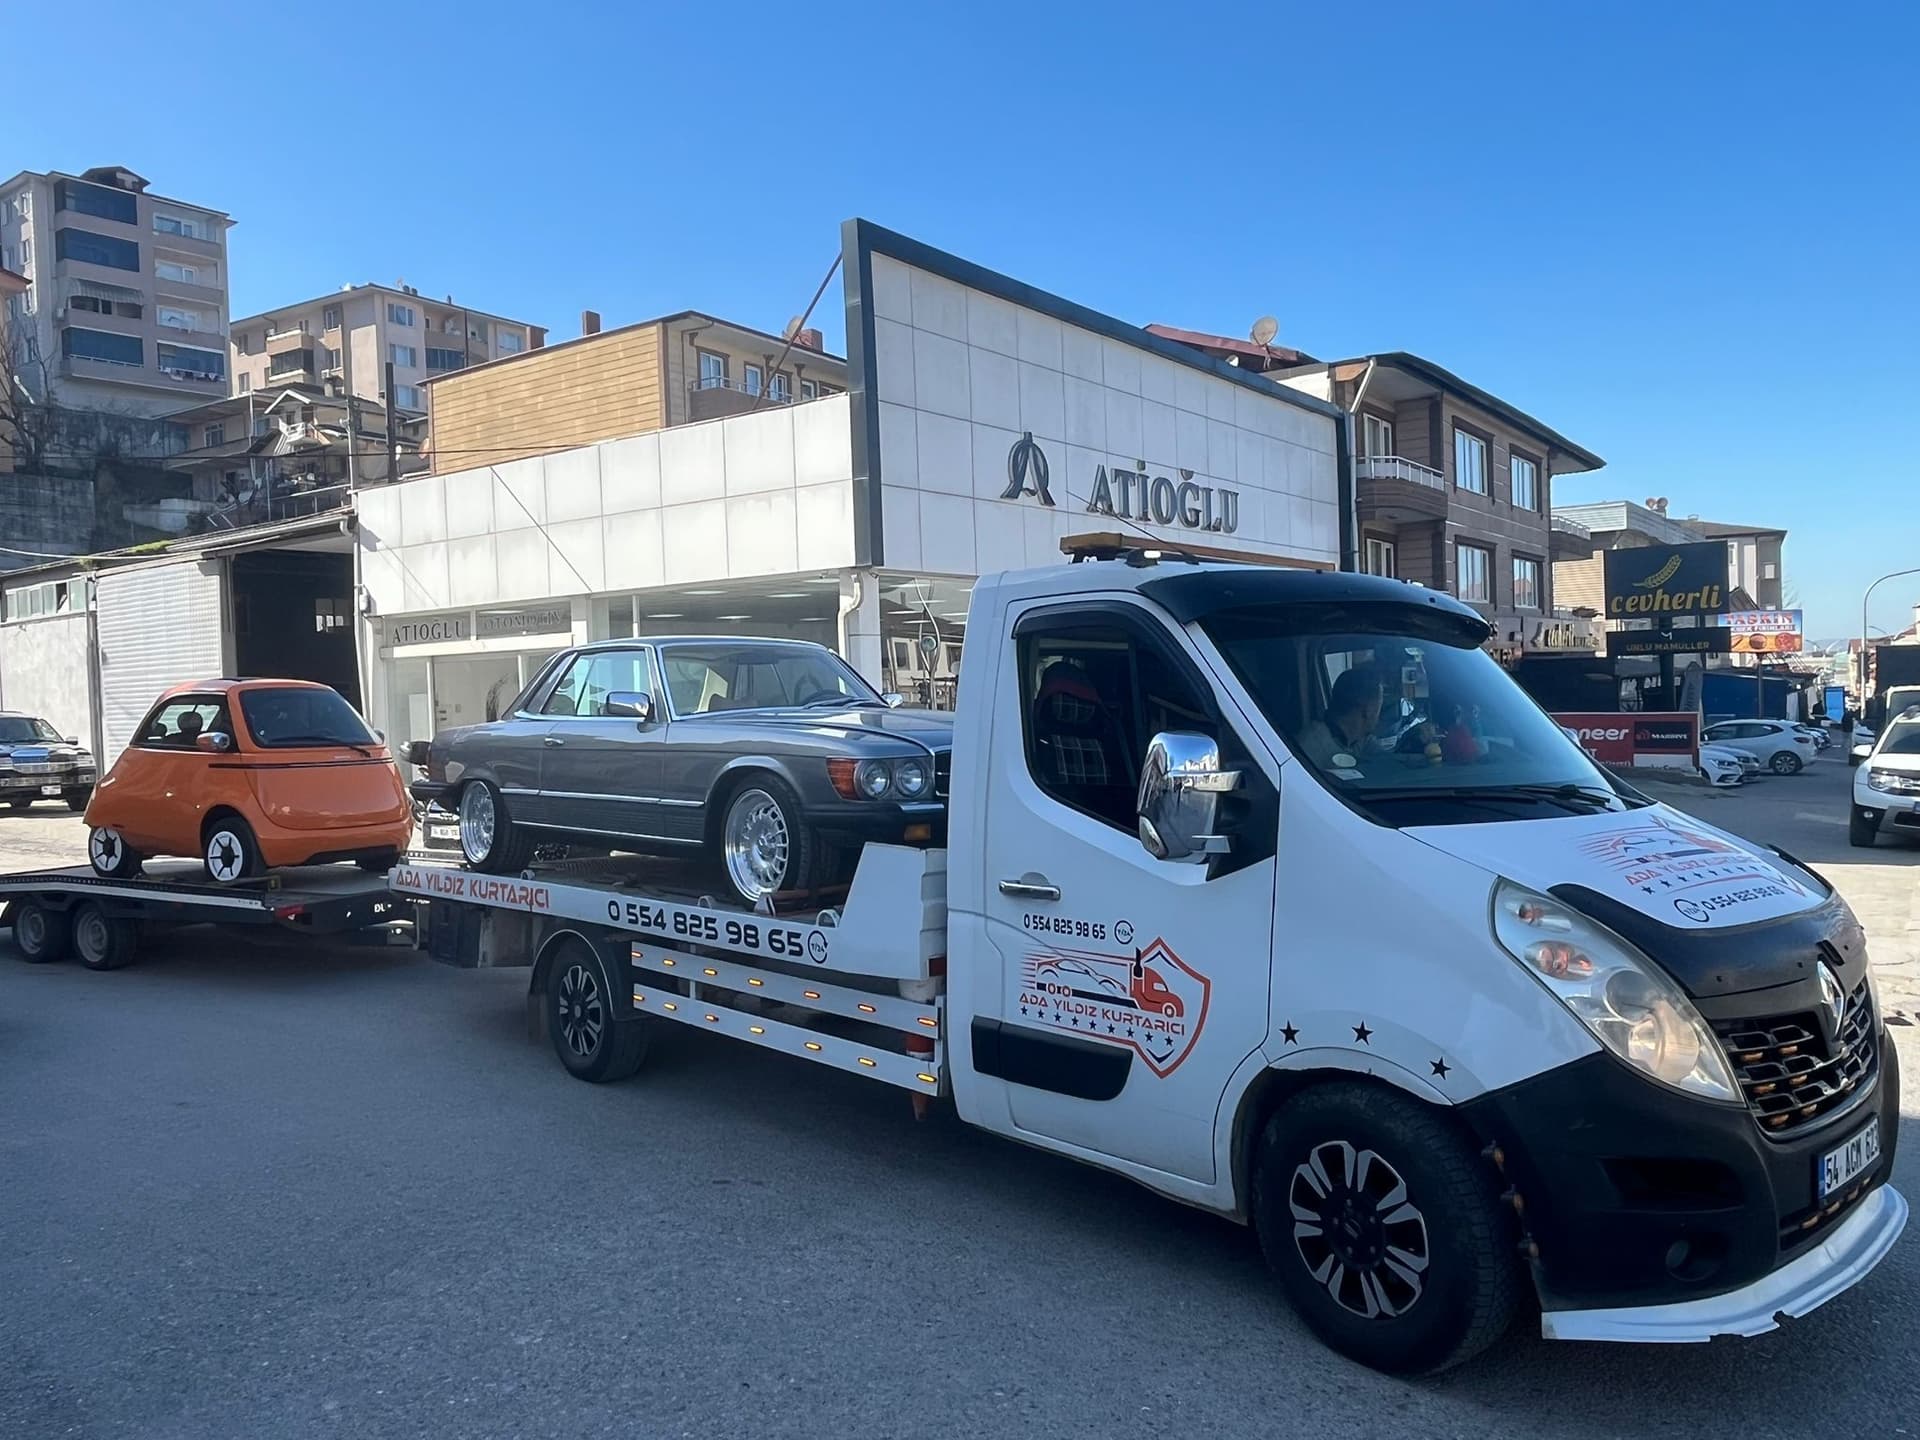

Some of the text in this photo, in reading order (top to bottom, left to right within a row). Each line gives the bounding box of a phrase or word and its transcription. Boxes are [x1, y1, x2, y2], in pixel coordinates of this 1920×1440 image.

[1086, 459, 1240, 534] ATİOĞLU
[1610, 585, 1722, 614] cevherli
[396, 869, 550, 909] ADA YILDIZ KURTARICI
[608, 900, 804, 957] 0 554 825 98 65
[1023, 913, 1106, 940] 0 554 825 98 65
[1019, 992, 1185, 1037] ADA YILDIZ KURTARICI
[1826, 1154, 1839, 1190] 54
